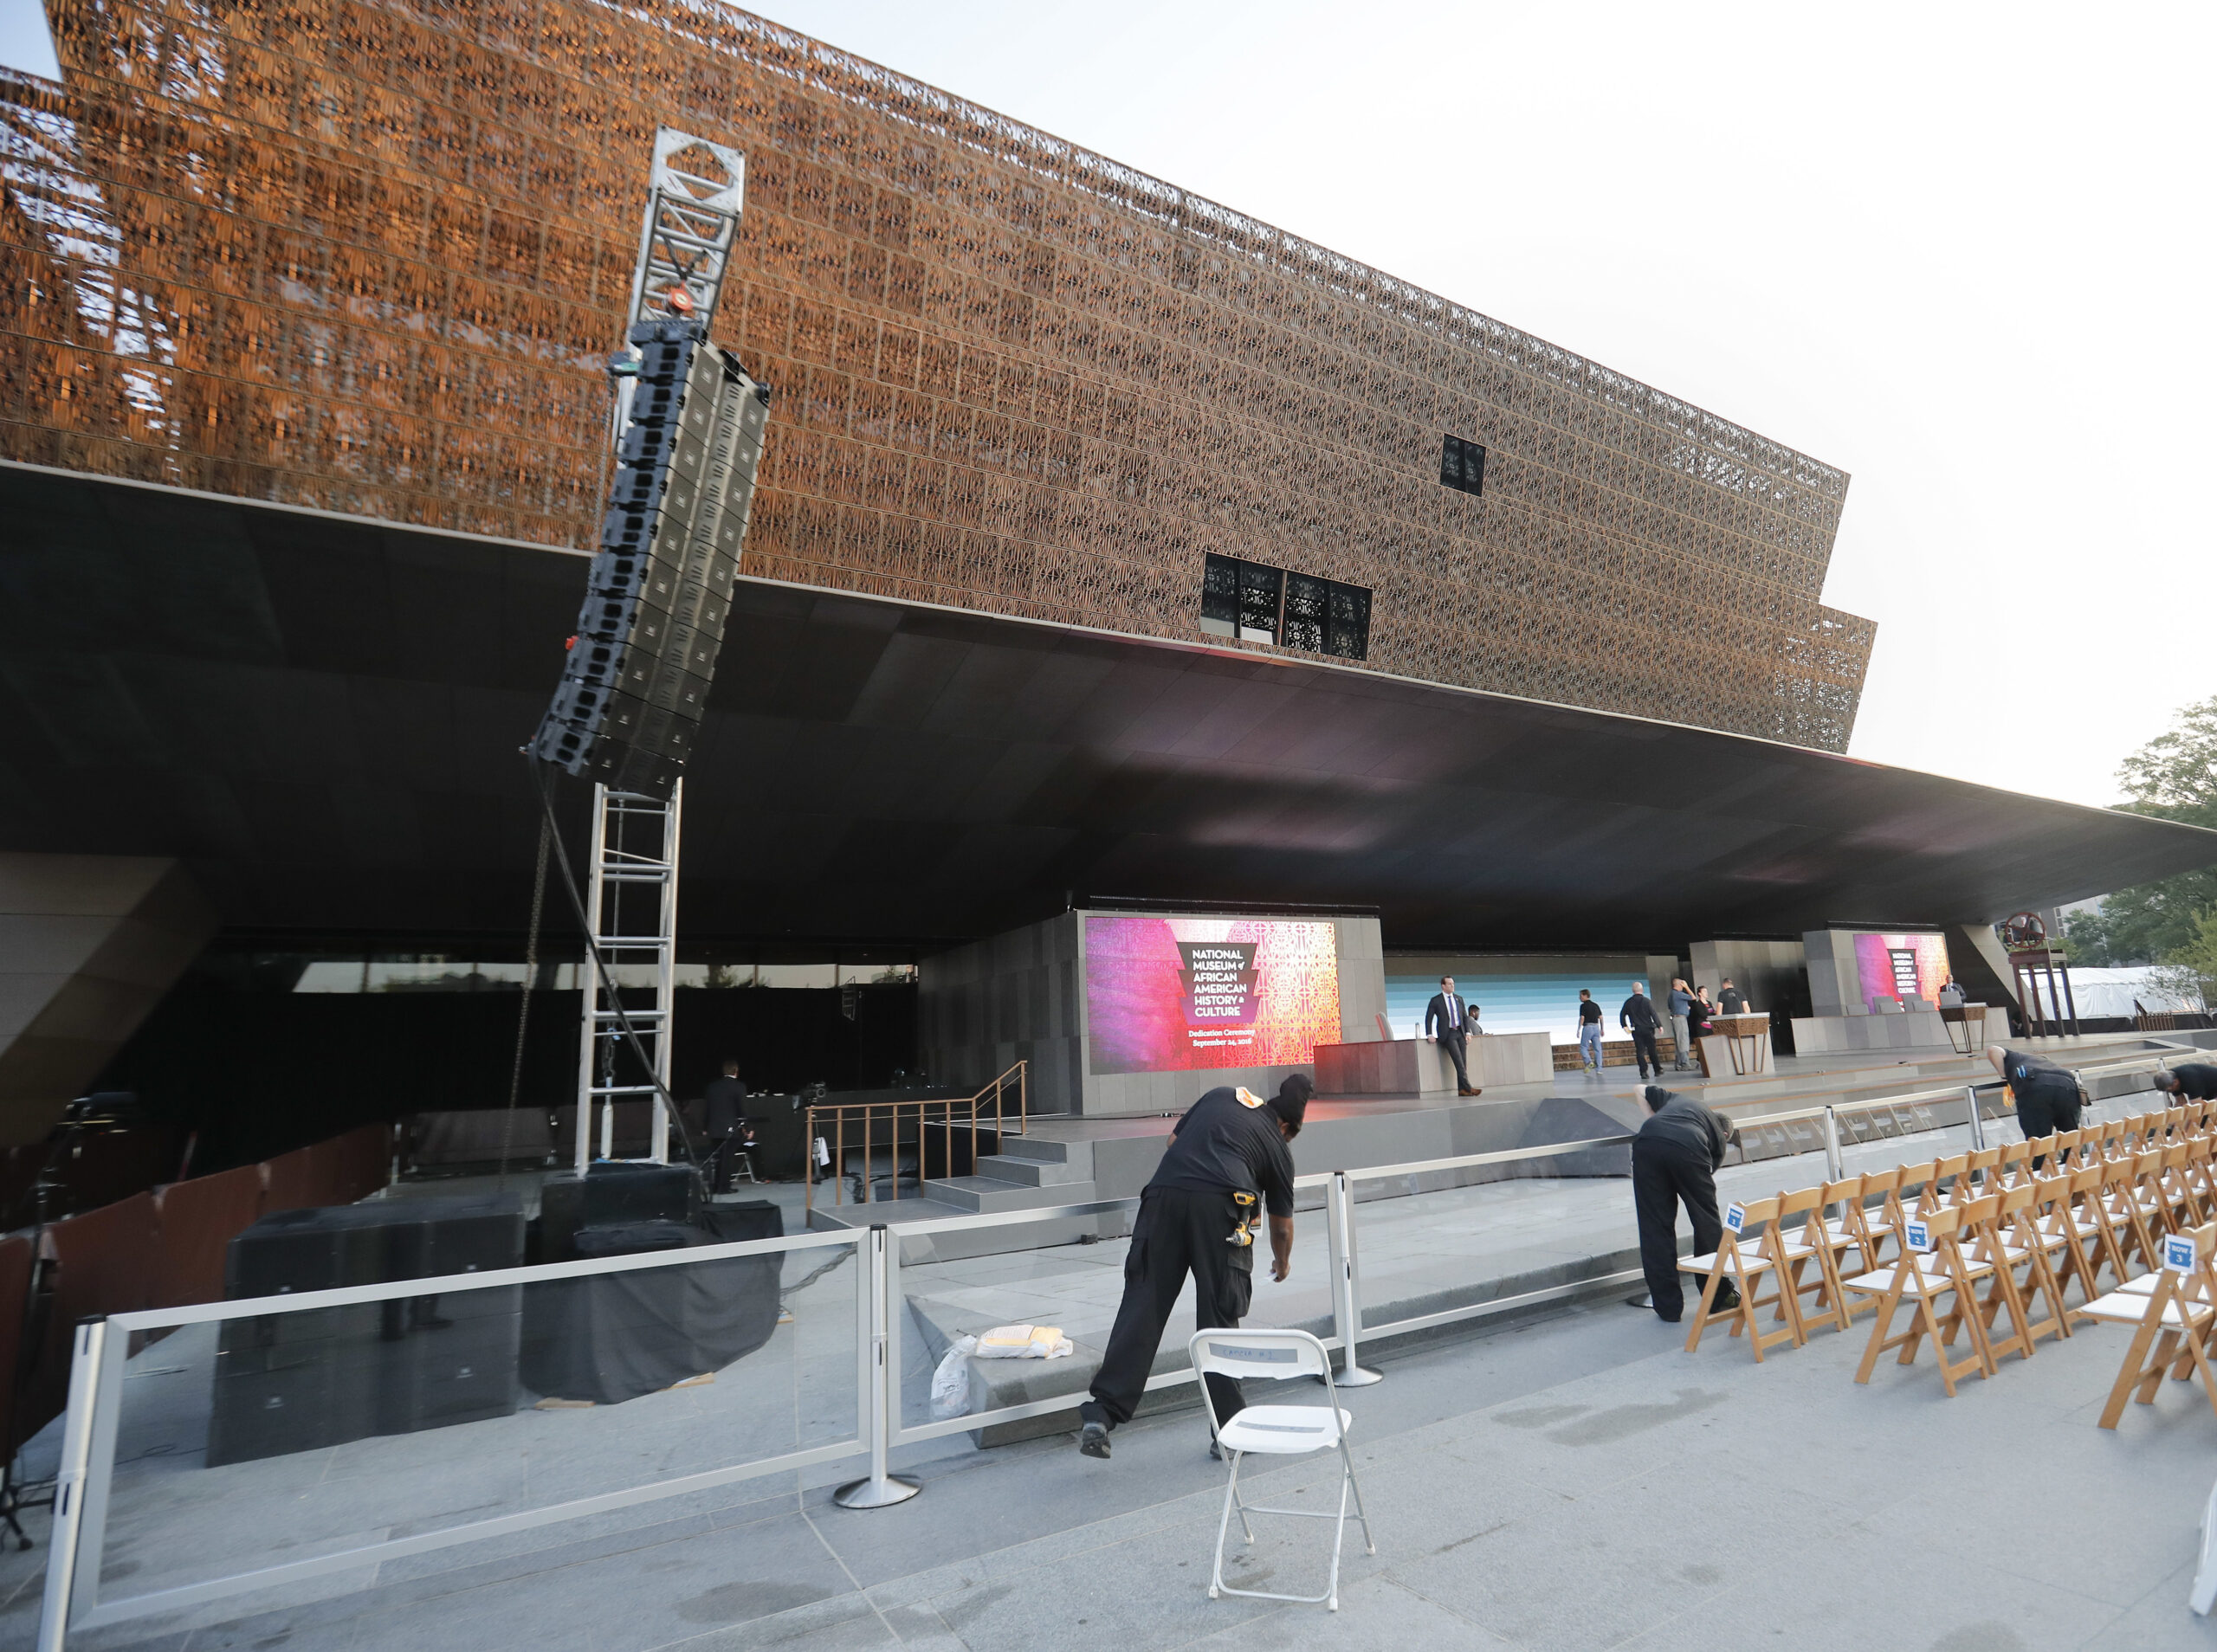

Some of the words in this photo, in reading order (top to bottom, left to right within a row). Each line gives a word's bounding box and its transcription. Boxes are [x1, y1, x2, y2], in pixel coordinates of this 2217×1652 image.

[1193, 949, 1244, 959] NATIONAL
[1193, 961, 1237, 971] MUSEUM
[1238, 961, 1245, 971] of
[1193, 972, 1238, 982] AFRICAN
[1193, 984, 1247, 994] AMERICAN
[1194, 995, 1238, 1005] HISTORY
[1194, 1006, 1241, 1017] CULTURE
[1223, 1029, 1256, 1037] Ceremony
[1193, 1038, 1226, 1049] September
[2171, 1244, 2188, 1255] ROW
[2175, 1254, 2183, 1263] 3
